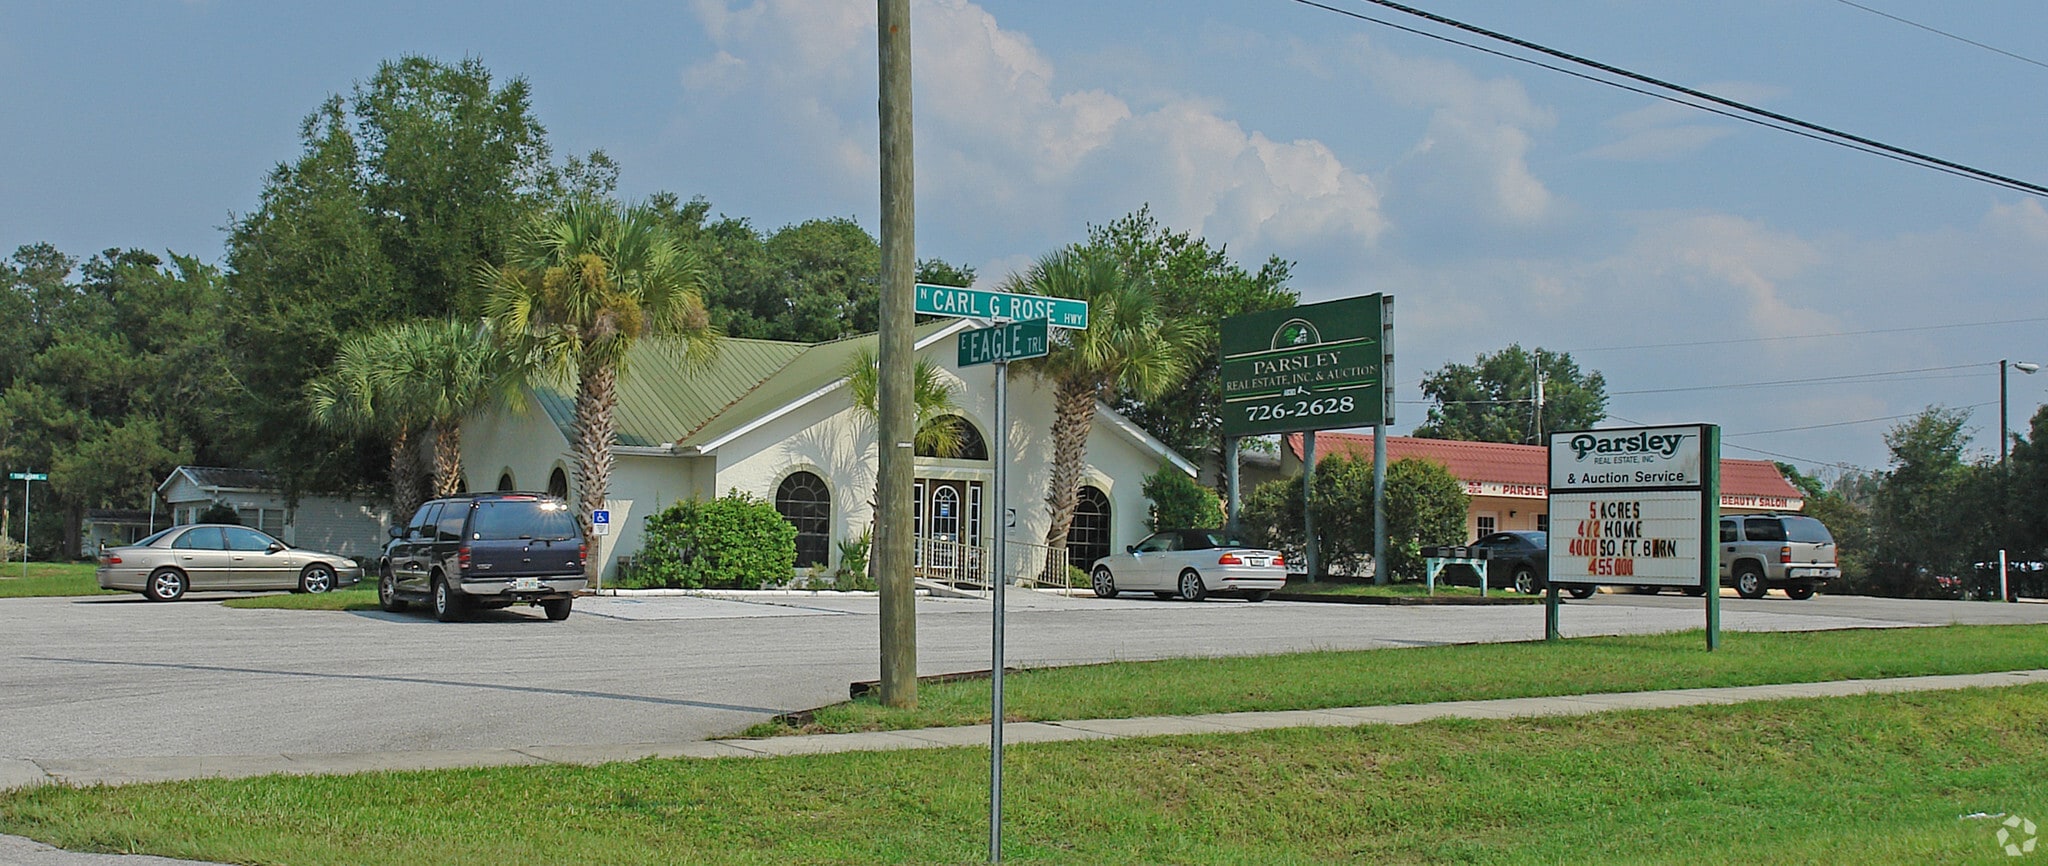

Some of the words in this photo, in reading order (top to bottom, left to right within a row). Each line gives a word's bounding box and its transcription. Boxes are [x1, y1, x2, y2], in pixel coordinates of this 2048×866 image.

[921, 288, 927, 300] N
[933, 290, 980, 314] CARL
[989, 295, 1000, 317] G
[1011, 298, 1056, 322] ROSE
[1064, 313, 1083, 325] HWY
[961, 334, 967, 350] E
[971, 325, 1022, 363] EAGLE
[1027, 335, 1044, 353] TRL
[1254, 351, 1341, 375] PARSLEY
[1226, 379, 1251, 392] REAL
[1252, 375, 1291, 390] ESTATE,
[1292, 373, 1314, 384] INC.
[1315, 371, 1325, 382] &
[1327, 364, 1378, 381] AUCTION
[1246, 396, 1355, 422] 726-2628
[1571, 432, 1683, 460] Parsley
[1594, 456, 1612, 465] REAL
[1567, 473, 1576, 484] &
[1582, 472, 1629, 484] Auction
[1635, 470, 1685, 483] Service
[1590, 502, 1597, 519] 5
[1600, 501, 1640, 519] ACRES
[1721, 495, 1757, 507] BEAUTY
[1759, 497, 1788, 508] SALON
[1577, 520, 1601, 538] 4/2
[1604, 520, 1643, 538] HOME
[1569, 538, 1597, 557] 4000
